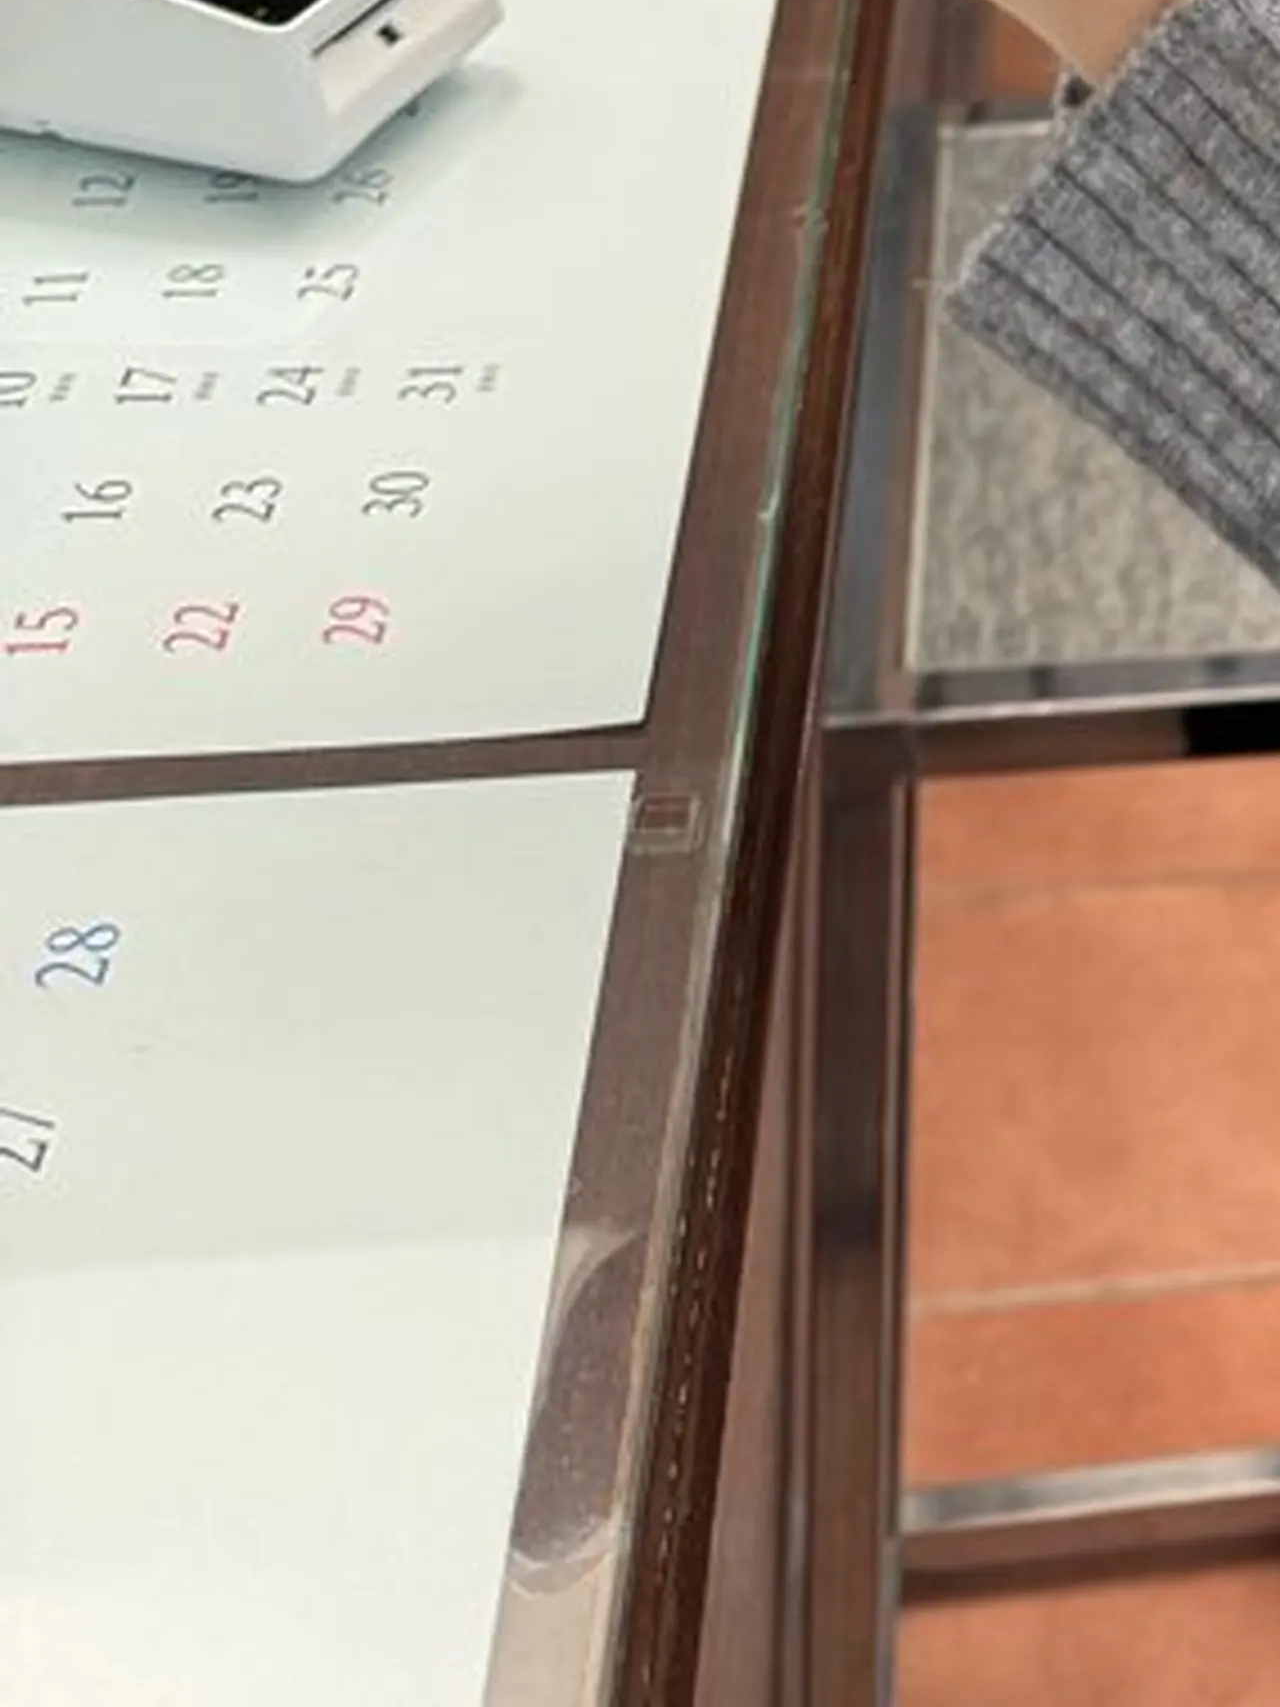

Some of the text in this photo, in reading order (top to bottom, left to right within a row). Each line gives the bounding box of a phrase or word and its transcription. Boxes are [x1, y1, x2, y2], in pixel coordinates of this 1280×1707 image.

[72, 173, 137, 207] 12
[205, 169, 261, 204] 19
[331, 167, 393, 206] 26
[22, 272, 89, 305] 11
[162, 264, 226, 298] 18
[297, 263, 360, 301] 25
[115, 367, 178, 404] 17
[256, 366, 325, 406] 24
[398, 366, 463, 404] 31
[61, 479, 133, 523] 16
[212, 476, 282, 523] 23
[362, 470, 430, 518] 30
[4, 606, 79, 656] 15
[163, 603, 239, 653] 22
[323, 596, 390, 644] 29
[34, 923, 120, 989] 28
